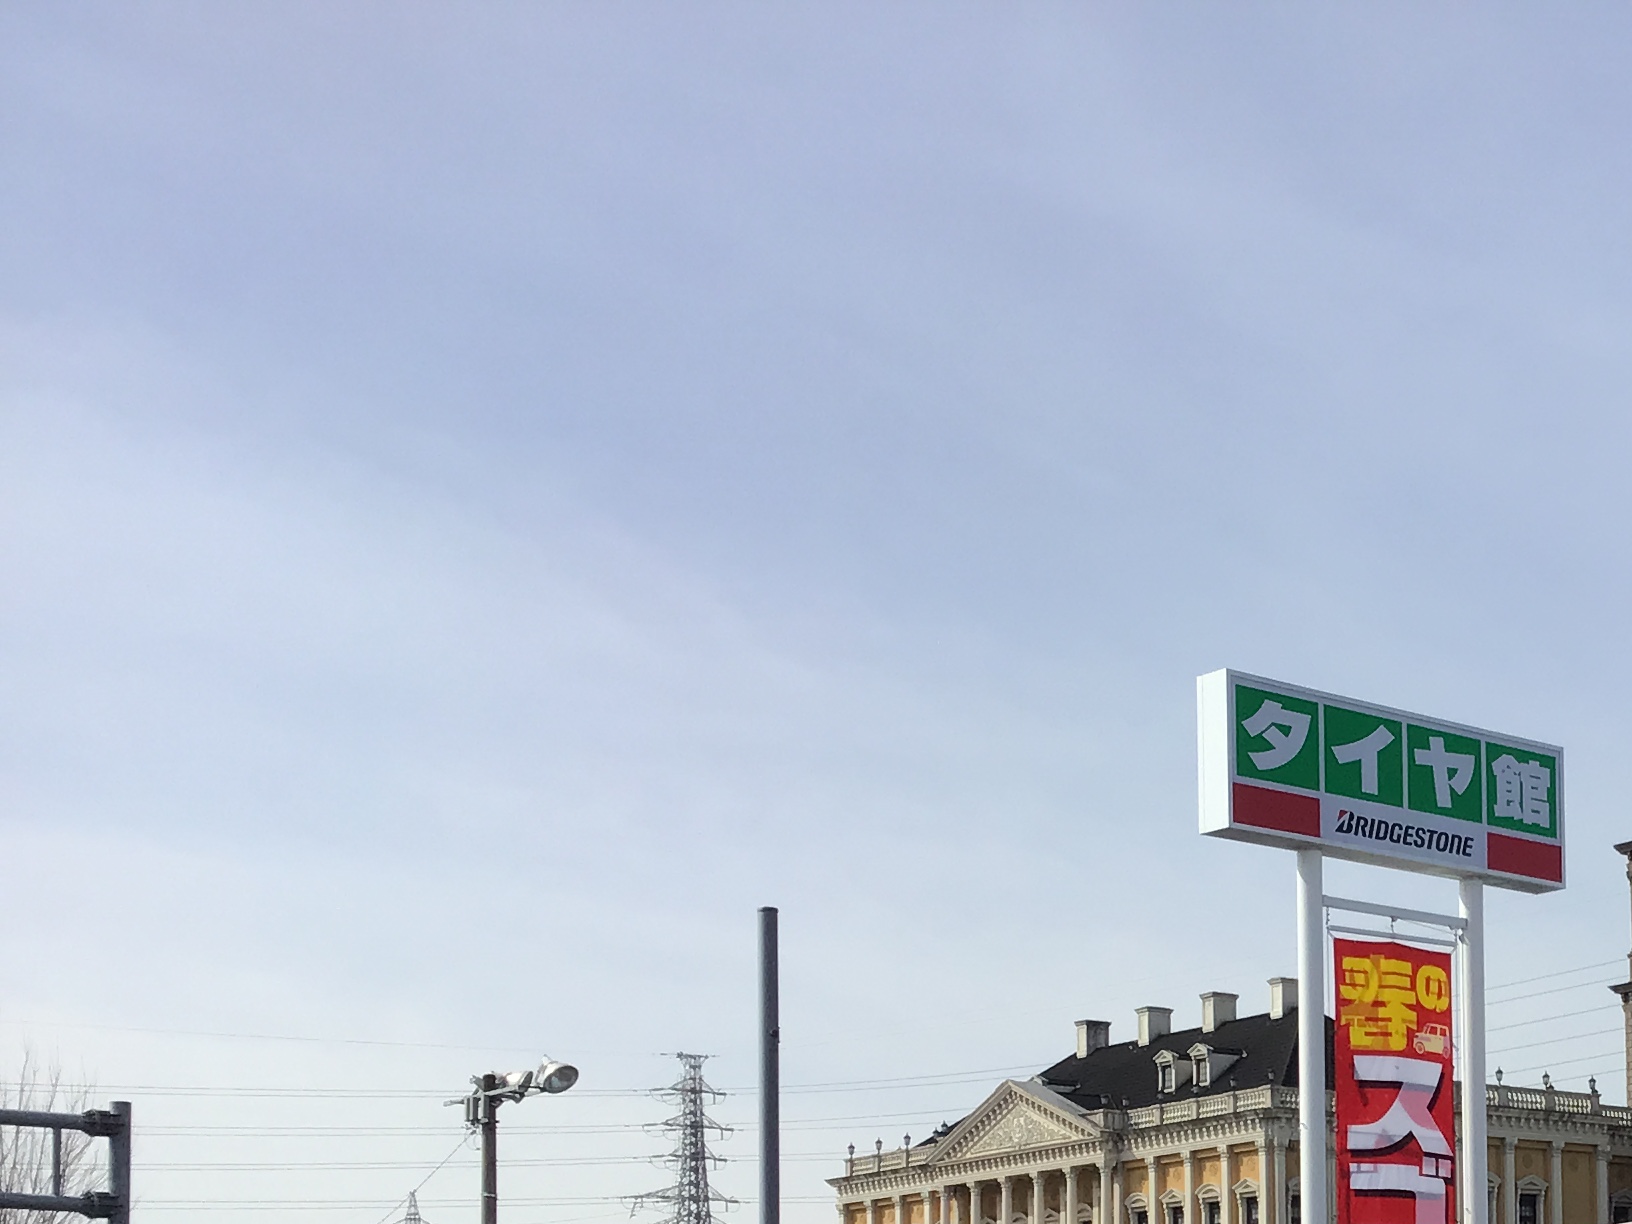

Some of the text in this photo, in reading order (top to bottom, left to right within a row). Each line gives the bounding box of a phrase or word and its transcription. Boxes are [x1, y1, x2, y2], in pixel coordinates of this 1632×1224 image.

[1241, 699, 1550, 829] タイヤ館
[1335, 809, 1475, 858] BRIDGESTONE
